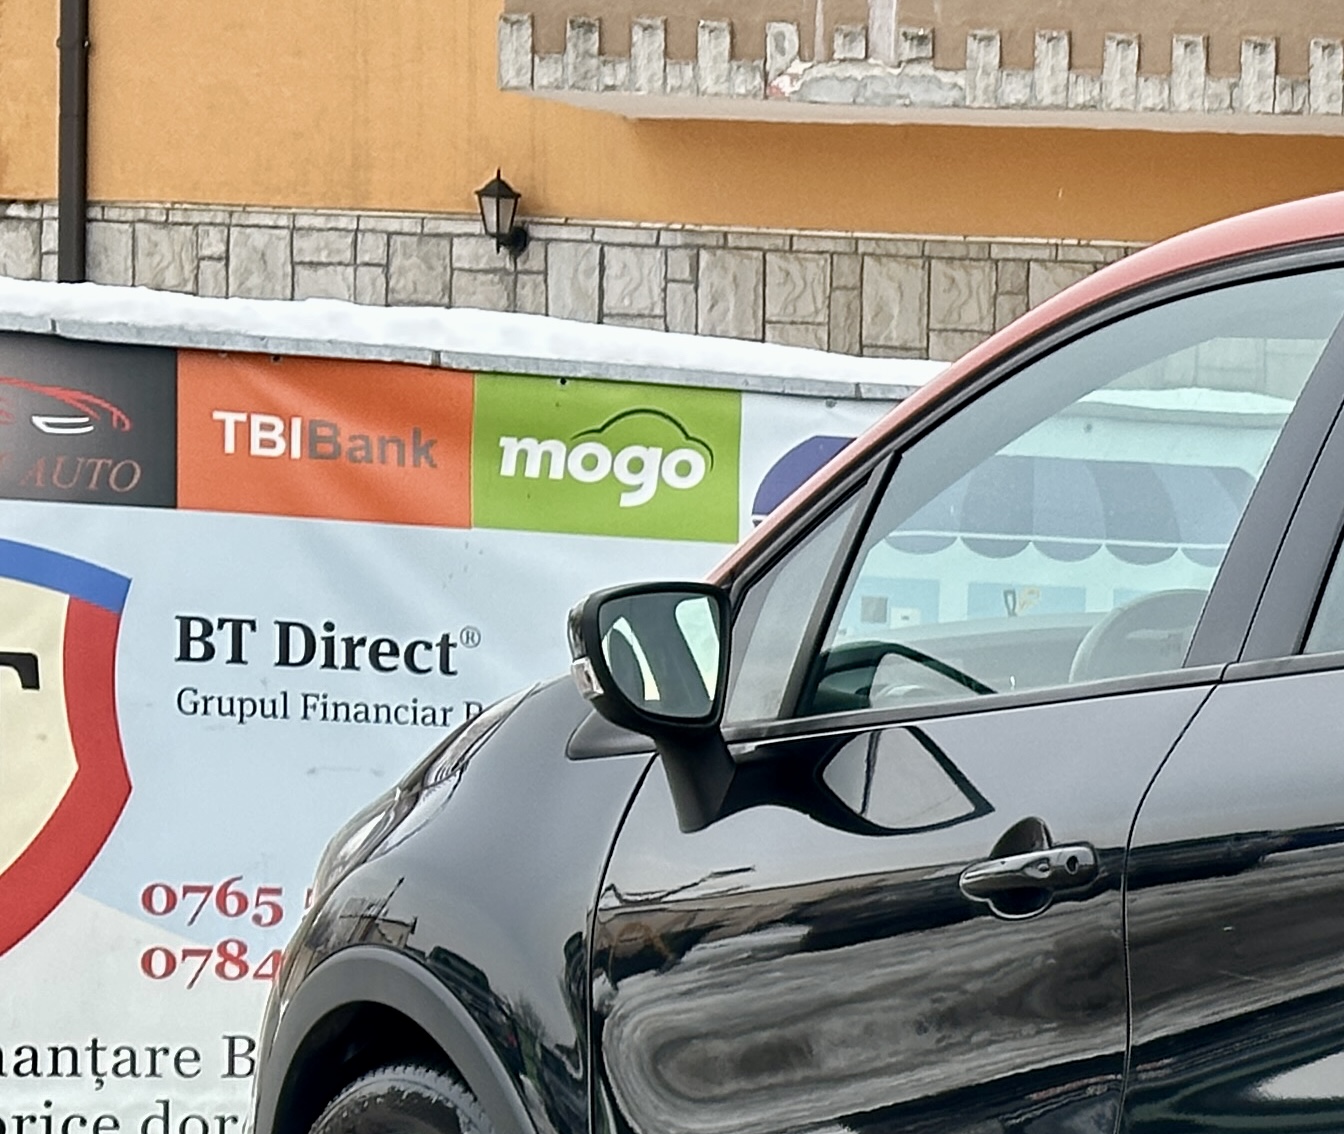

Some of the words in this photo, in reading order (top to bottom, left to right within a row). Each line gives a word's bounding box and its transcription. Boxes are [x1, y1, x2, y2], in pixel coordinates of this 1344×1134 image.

[19, 454, 142, 494] AUTO
[500, 435, 706, 507] mogo
[174, 615, 257, 665] BT
[176, 687, 290, 725] Grupul
[301, 692, 454, 727] Financiar
[141, 875, 284, 927] 0765
[0, 1037, 202, 1090] anțare
